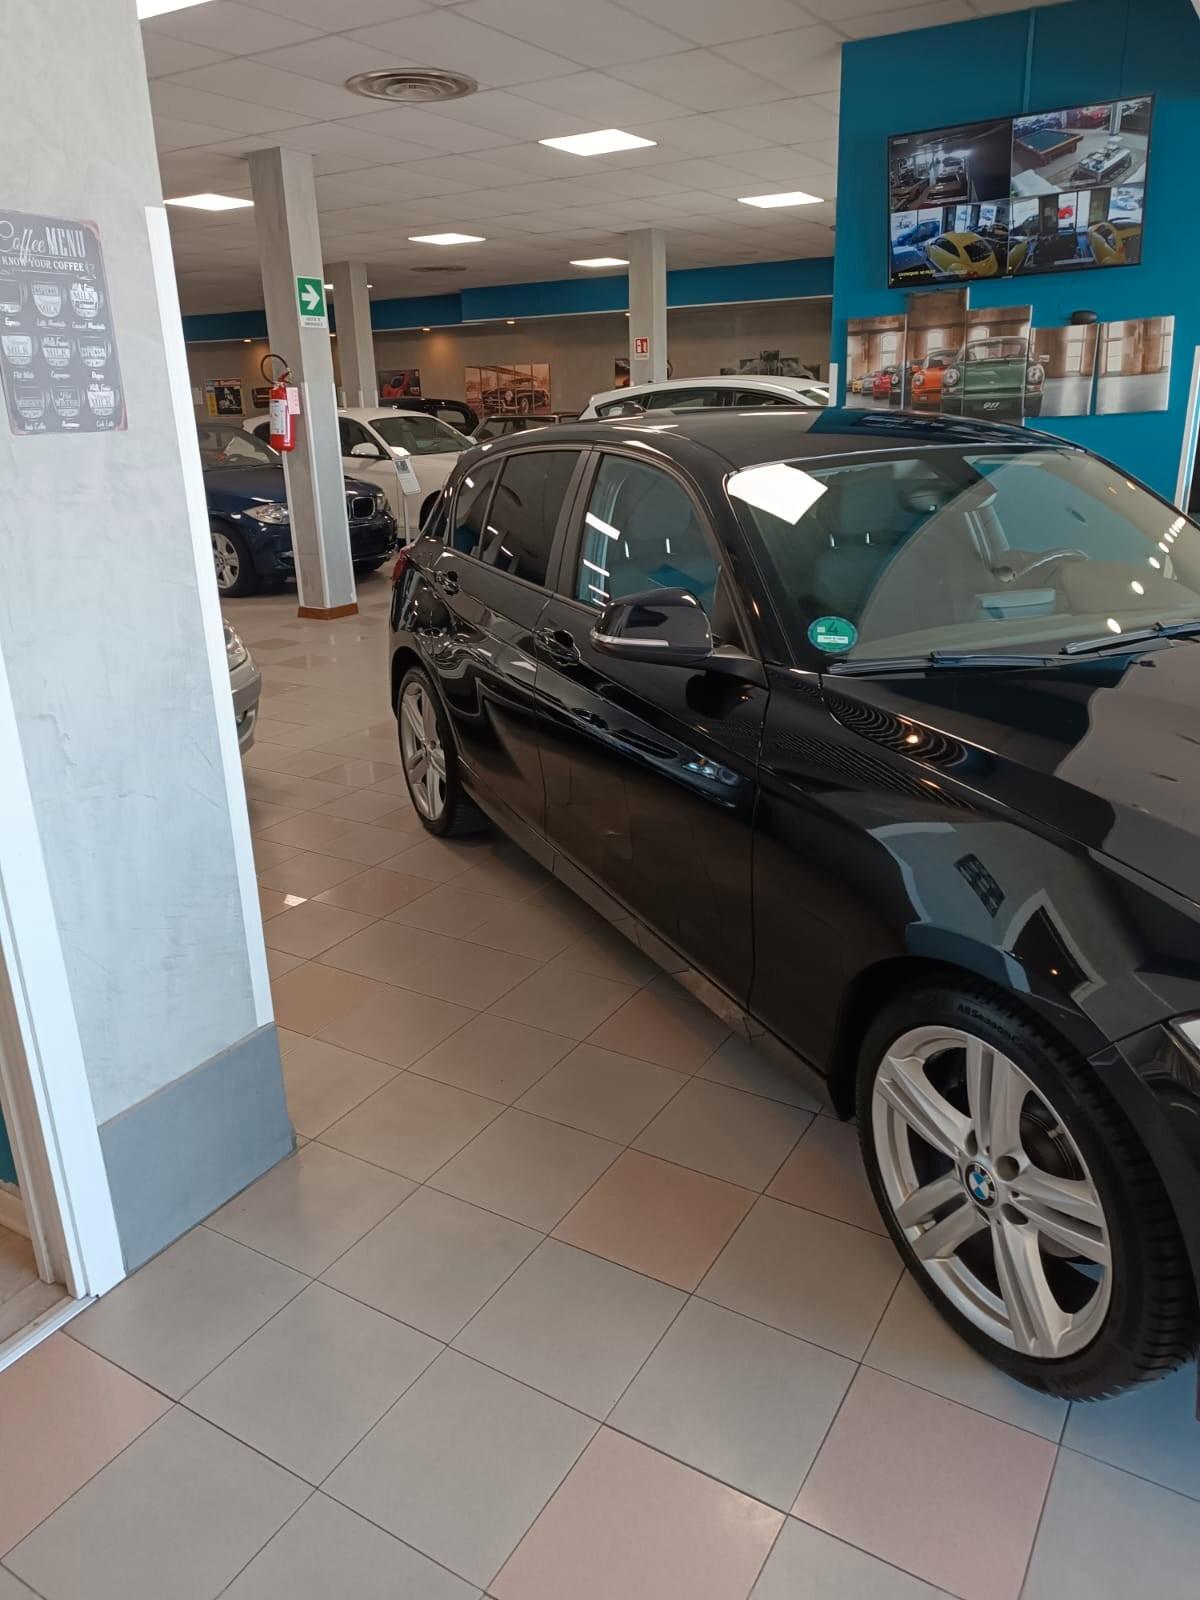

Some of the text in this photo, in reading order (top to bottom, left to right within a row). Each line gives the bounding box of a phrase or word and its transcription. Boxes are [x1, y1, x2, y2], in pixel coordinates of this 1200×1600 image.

[45, 227, 86, 258] MENU
[30, 257, 52, 269] YOUR
[53, 260, 85, 272] COFFEE
[826, 621, 840, 635] 4
